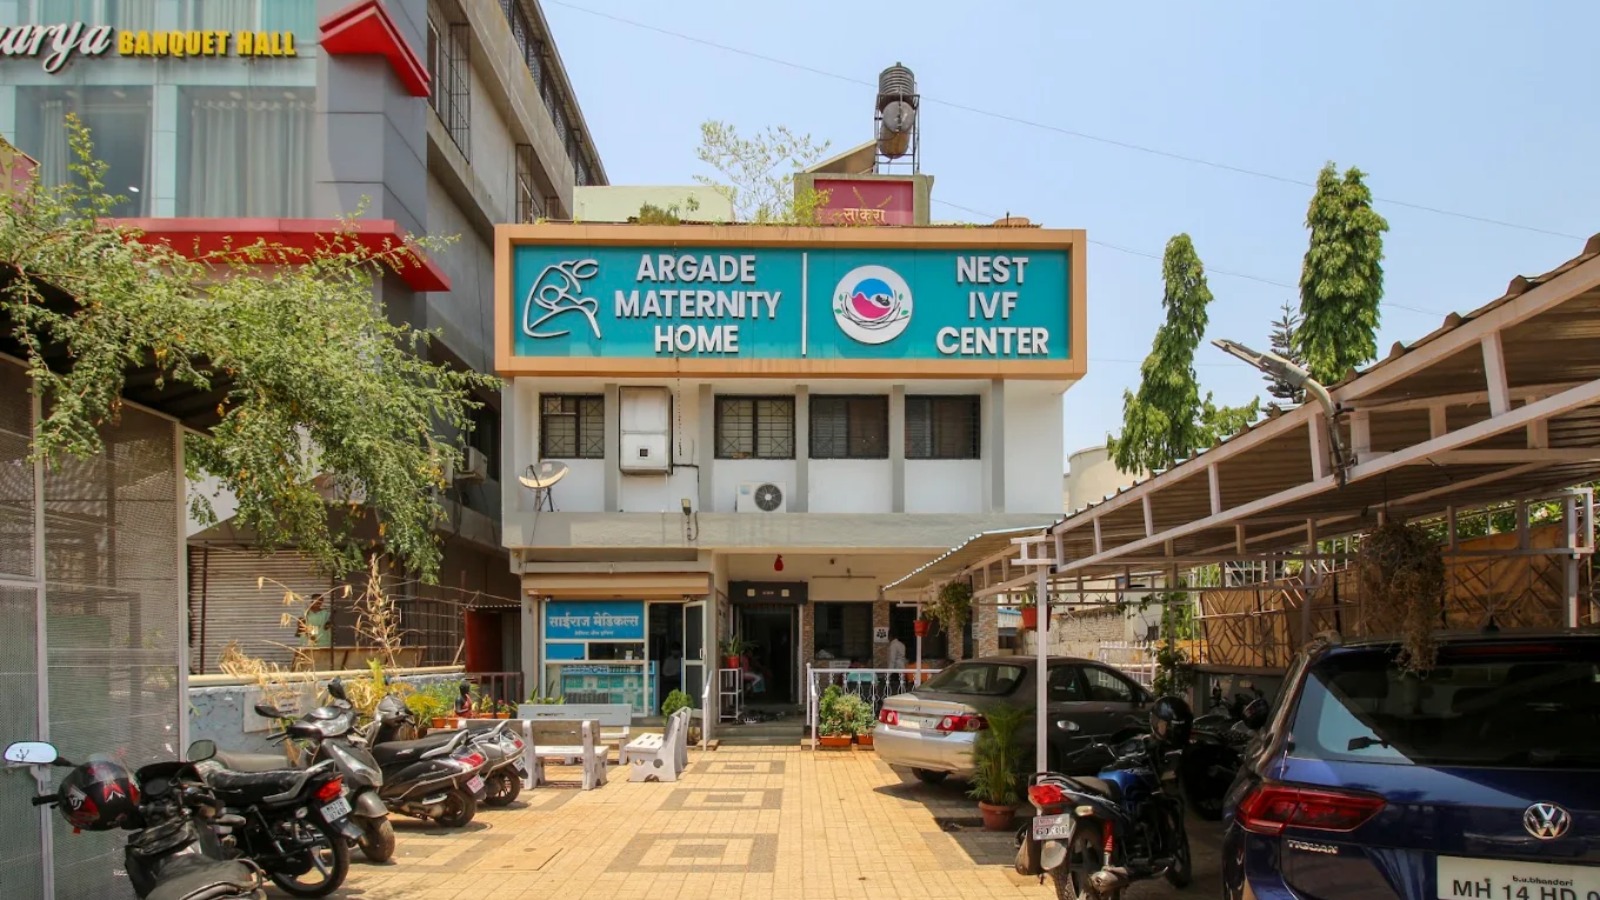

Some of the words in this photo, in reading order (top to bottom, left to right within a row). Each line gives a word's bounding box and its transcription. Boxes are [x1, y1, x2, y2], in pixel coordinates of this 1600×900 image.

[118, 31, 230, 57] BANQUET
[237, 31, 296, 56] HALL
[636, 254, 756, 282] ARGADE
[956, 255, 1029, 284] NEST
[614, 290, 781, 319] MATERNITY
[968, 291, 1018, 319] IVF
[655, 325, 739, 353] HOME
[936, 326, 1049, 355] CENTER
[1287, 839, 1339, 855] TIGUAN
[1453, 879, 1491, 899] MH
[1502, 884, 1530, 900] 14
[1540, 886, 1577, 900] HD
